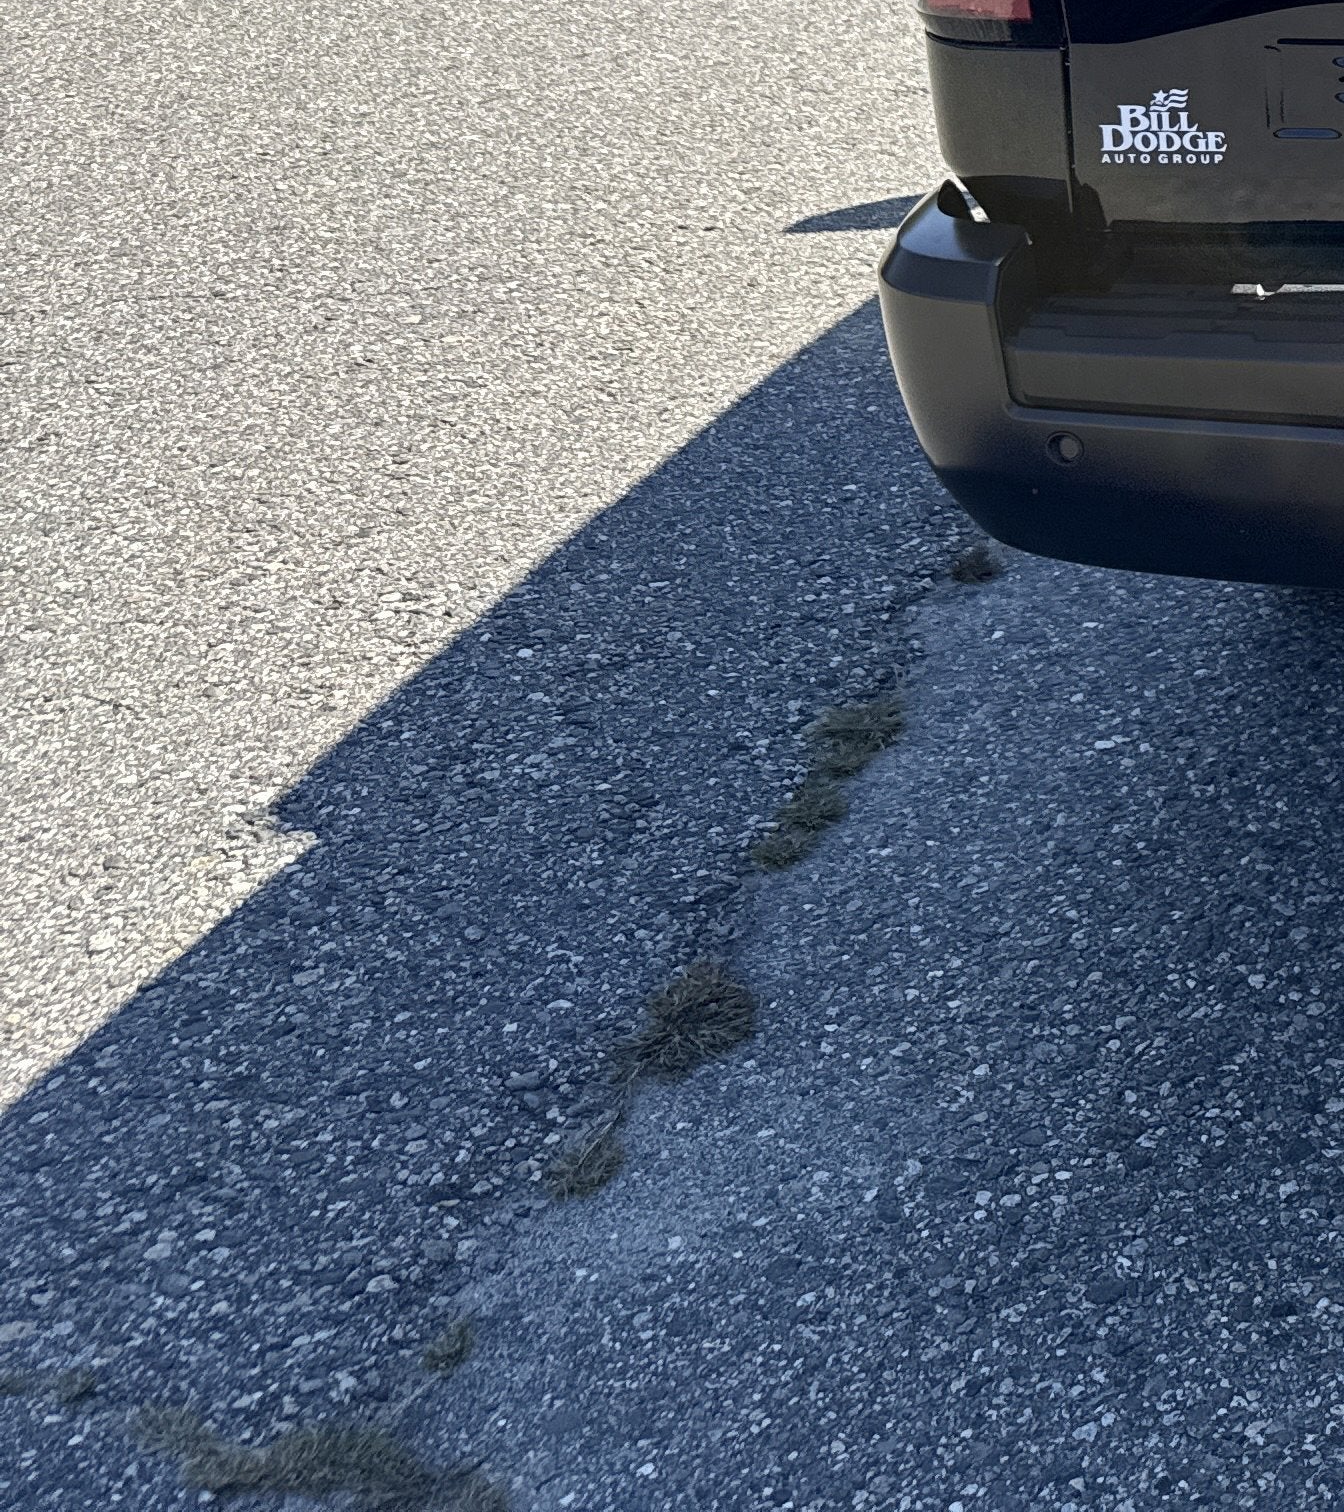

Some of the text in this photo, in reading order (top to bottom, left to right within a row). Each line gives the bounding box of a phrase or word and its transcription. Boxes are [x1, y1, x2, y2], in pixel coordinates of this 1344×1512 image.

[1117, 104, 1199, 132] BILL
[1098, 124, 1228, 153] DODGE
[1101, 153, 1224, 164] AUTO GROUP
